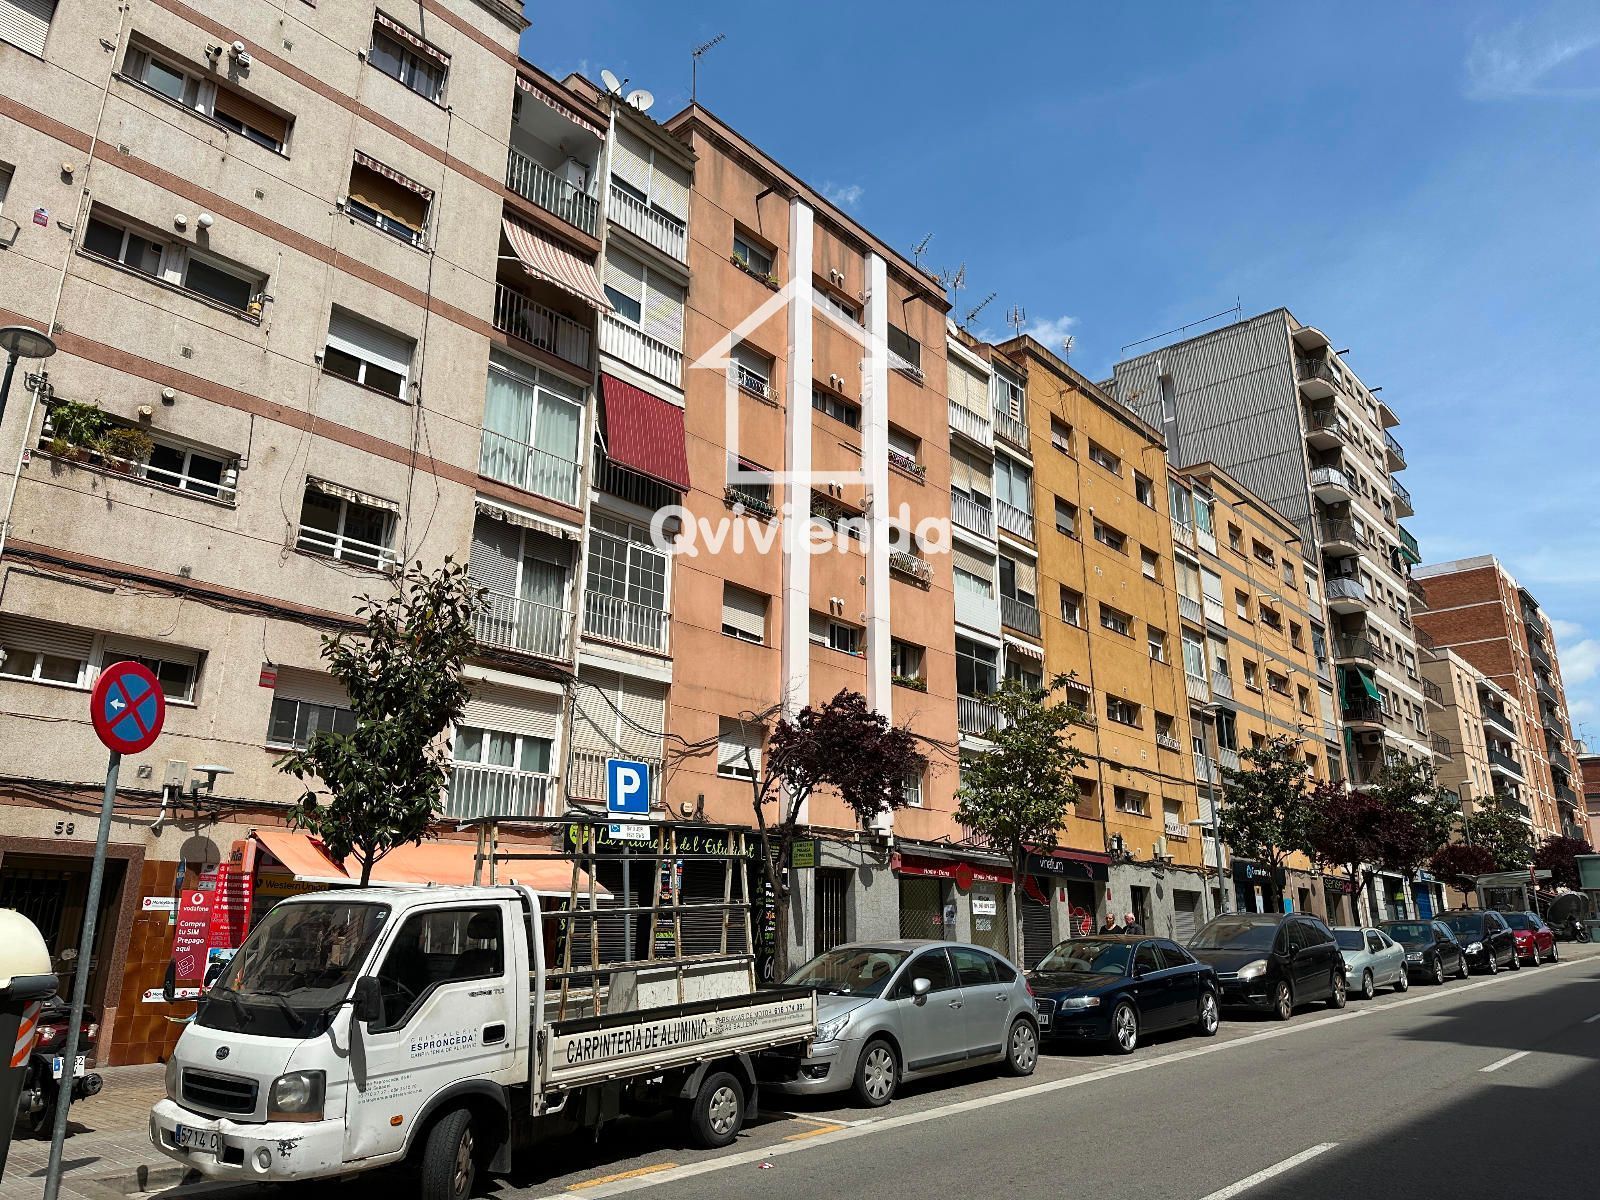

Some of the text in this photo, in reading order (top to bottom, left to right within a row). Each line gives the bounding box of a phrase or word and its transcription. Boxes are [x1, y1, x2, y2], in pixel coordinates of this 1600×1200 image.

[616, 767, 641, 806] P
[54, 821, 75, 835] 58
[680, 837, 692, 851] de
[265, 880, 326, 891] Western Union
[180, 920, 206, 929] Compra
[176, 937, 205, 945] Prepago
[644, 1026, 659, 1049] DE
[659, 1018, 708, 1046] ALUMINIO
[411, 1034, 474, 1052] ESPRONCEDA
[181, 1127, 206, 1148] 5714
